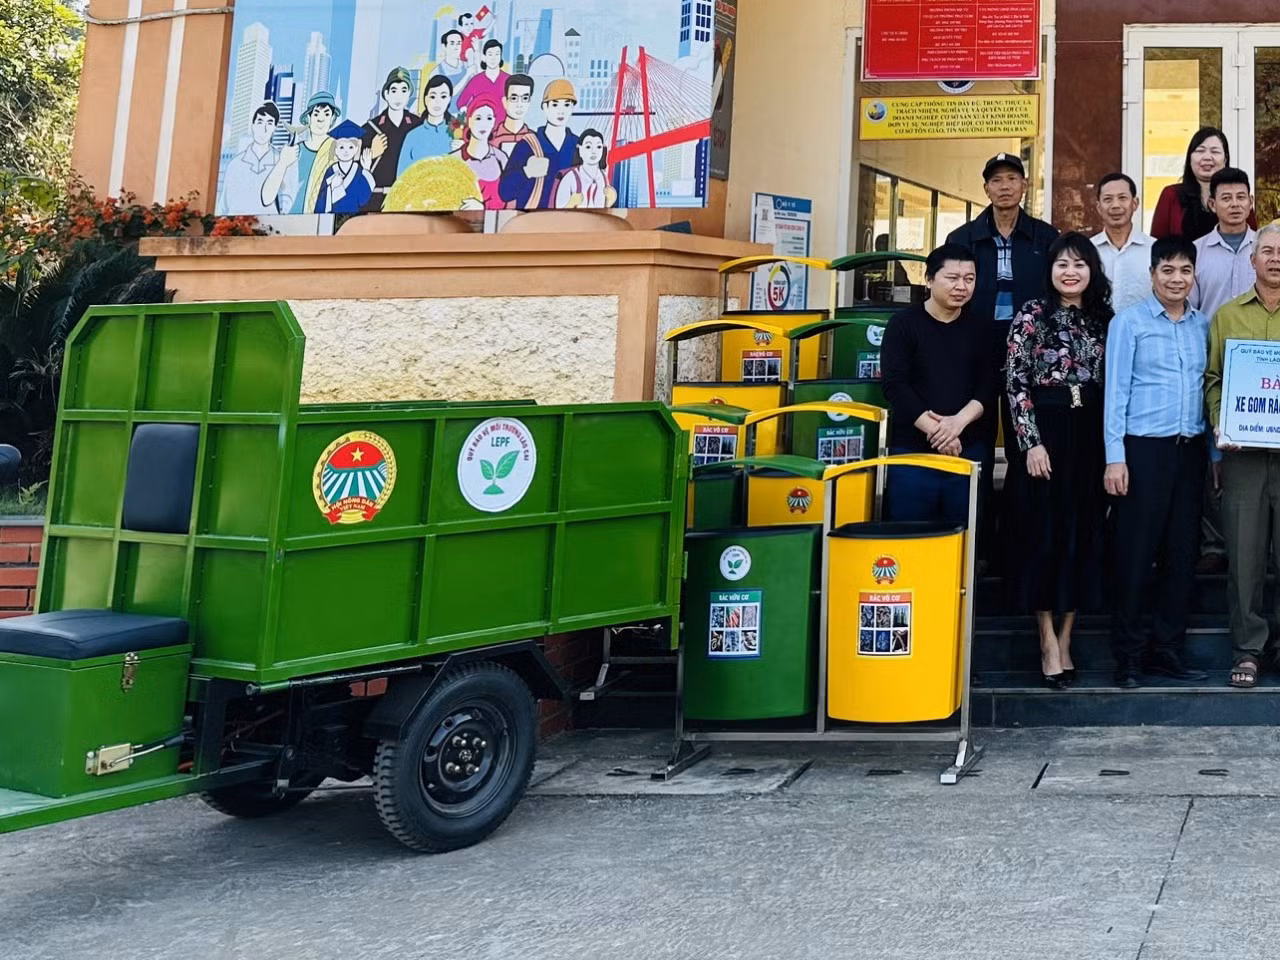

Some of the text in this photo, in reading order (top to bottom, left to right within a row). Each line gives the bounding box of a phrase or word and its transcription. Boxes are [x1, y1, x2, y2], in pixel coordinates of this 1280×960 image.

[773, 287, 785, 301] 5K
[1235, 396, 1245, 412] XE
[1248, 398, 1266, 413] GOM
[491, 436, 510, 447] LEPF
